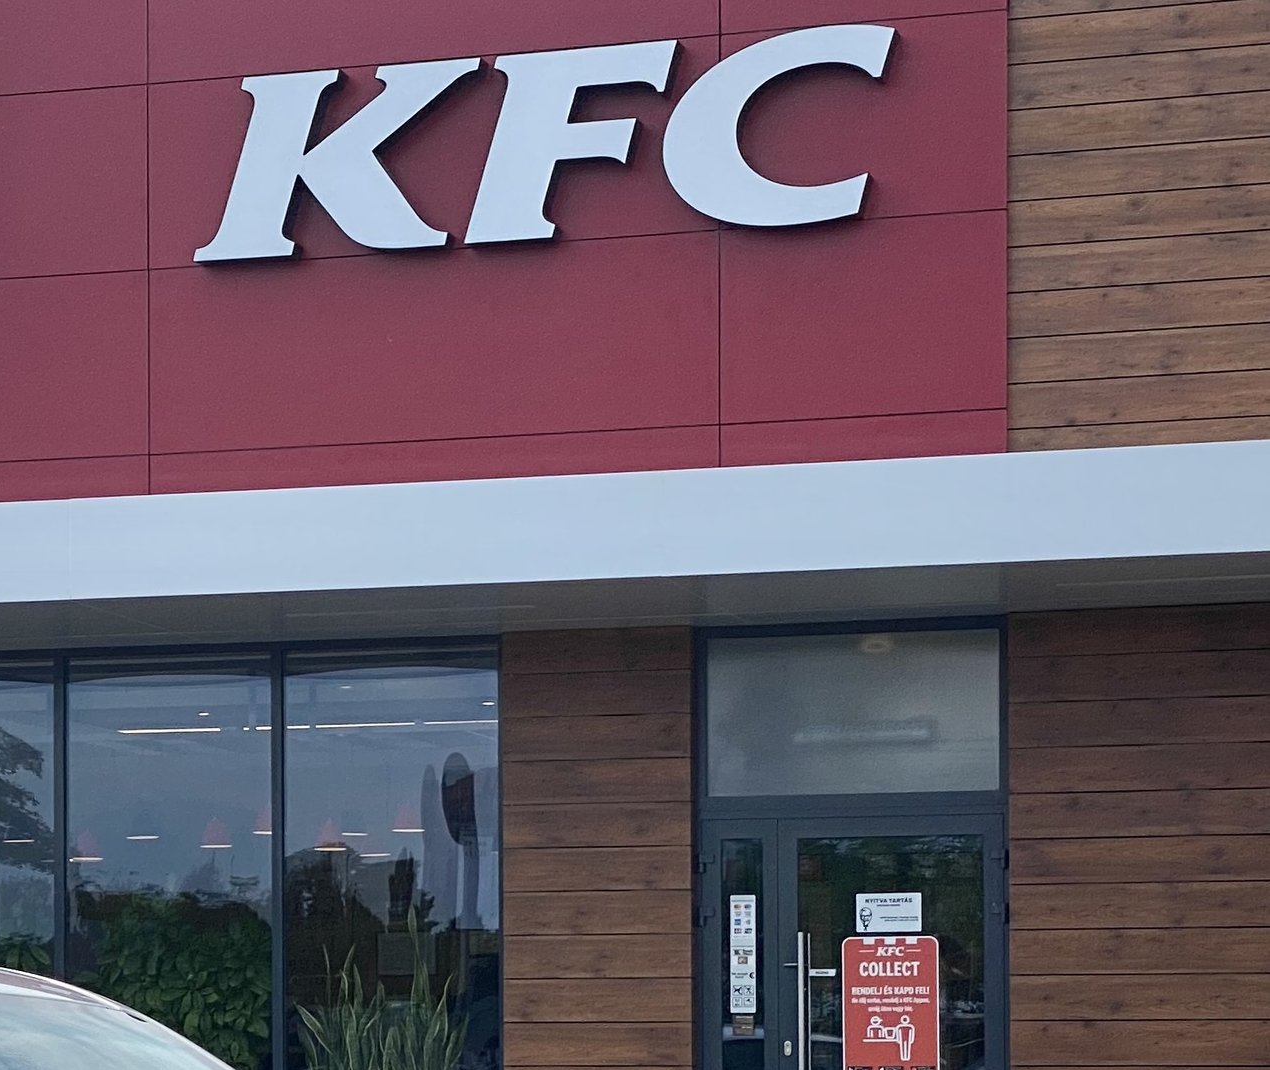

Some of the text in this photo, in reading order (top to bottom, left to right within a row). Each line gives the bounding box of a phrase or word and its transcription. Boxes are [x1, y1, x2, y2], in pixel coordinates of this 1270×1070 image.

[193, 24, 896, 262] KFC
[875, 946, 905, 957] KFC
[859, 961, 921, 977] COLLECT
[851, 986, 883, 996] RENDELJ
[883, 984, 893, 995] ÉS
[894, 986, 914, 995] KAPD
